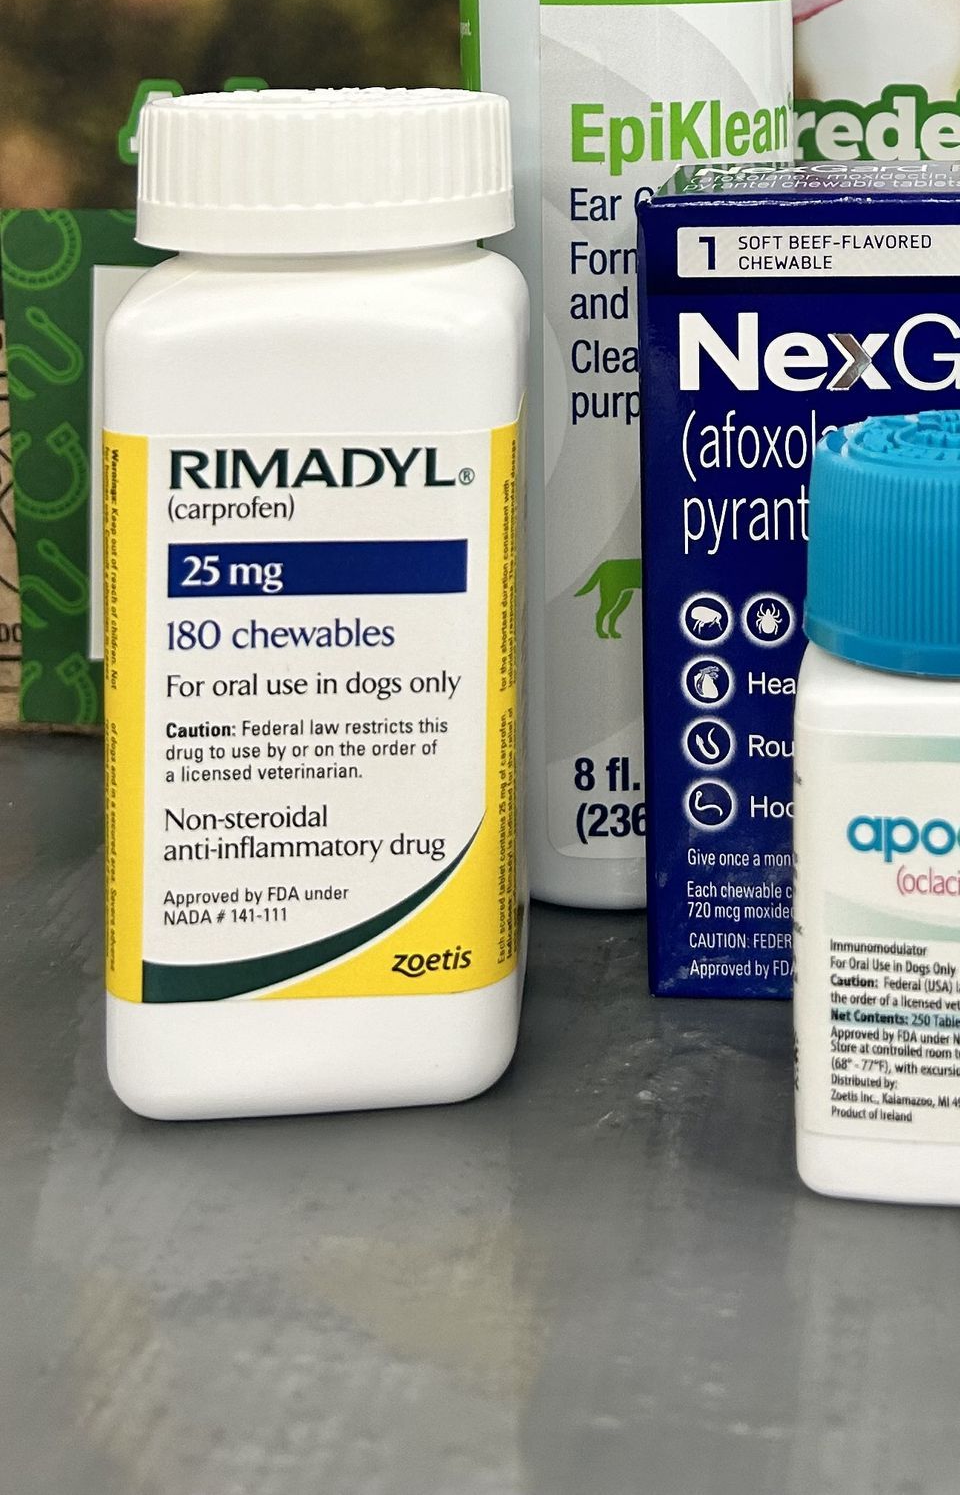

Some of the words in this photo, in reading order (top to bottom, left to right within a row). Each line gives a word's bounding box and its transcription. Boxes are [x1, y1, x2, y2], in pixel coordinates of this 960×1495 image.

[571, 188, 622, 221] Ear
[699, 236, 716, 271] 1
[738, 235, 783, 251] SOFT
[789, 234, 932, 251] BEEF-FLAVORED
[738, 255, 833, 271] CHEWABLE
[571, 286, 629, 320] and
[168, 493, 295, 525] (carprofen)
[683, 484, 810, 556] pyrant
[181, 556, 220, 585] 25
[229, 561, 284, 594] mg
[167, 618, 221, 651] 180
[232, 616, 395, 649] chewables
[167, 674, 205, 698] For
[212, 673, 258, 696] oral
[266, 677, 308, 695] use
[316, 672, 338, 695] in
[345, 671, 401, 700] dogs
[409, 669, 461, 699] only
[166, 721, 236, 738] Caution:
[242, 719, 304, 736] Federal
[310, 719, 340, 735] law
[345, 718, 414, 735] restricts
[418, 717, 448, 734] this
[166, 744, 204, 764] drug
[209, 745, 225, 759] to
[232, 746, 261, 759] use
[267, 742, 287, 761] by
[292, 745, 308, 757] or
[314, 744, 334, 757] on
[339, 741, 366, 756] the
[372, 740, 416, 756] order
[422, 739, 439, 755] of
[166, 770, 175, 783] a
[181, 764, 252, 782] licensed
[258, 762, 363, 780] veterinarian.
[574, 757, 596, 791] 8
[606, 757, 641, 791] fl.
[164, 805, 328, 832] Non-steroidal
[164, 834, 383, 863] anti-inflammatory
[390, 833, 446, 861] drug
[687, 848, 715, 866] Give
[719, 853, 749, 866] once
[753, 853, 761, 866] a
[164, 889, 240, 906] Approved
[244, 888, 263, 905] by
[267, 886, 300, 902] FDA
[305, 886, 349, 901] under
[687, 881, 717, 898] Each
[720, 881, 782, 899] chewable
[164, 911, 213, 926] NADA
[216, 910, 226, 924] #
[232, 907, 288, 923] 141-111
[688, 901, 711, 918] 720
[715, 905, 740, 922] mcg
[689, 932, 750, 949] CAUTION:
[830, 939, 928, 957] Immunomodulator
[391, 947, 472, 978] zoetis
[690, 959, 751, 979] Approved
[755, 960, 770, 979] by
[830, 956, 847, 969] For
[850, 957, 869, 971] Oral
[872, 958, 890, 972] Use
[893, 959, 902, 972] in
[905, 960, 930, 977] Dogs
[932, 962, 957, 978] Only
[830, 1009, 851, 1023] Net
[854, 1010, 908, 1026] Contents:
[911, 1014, 930, 1026] 250
